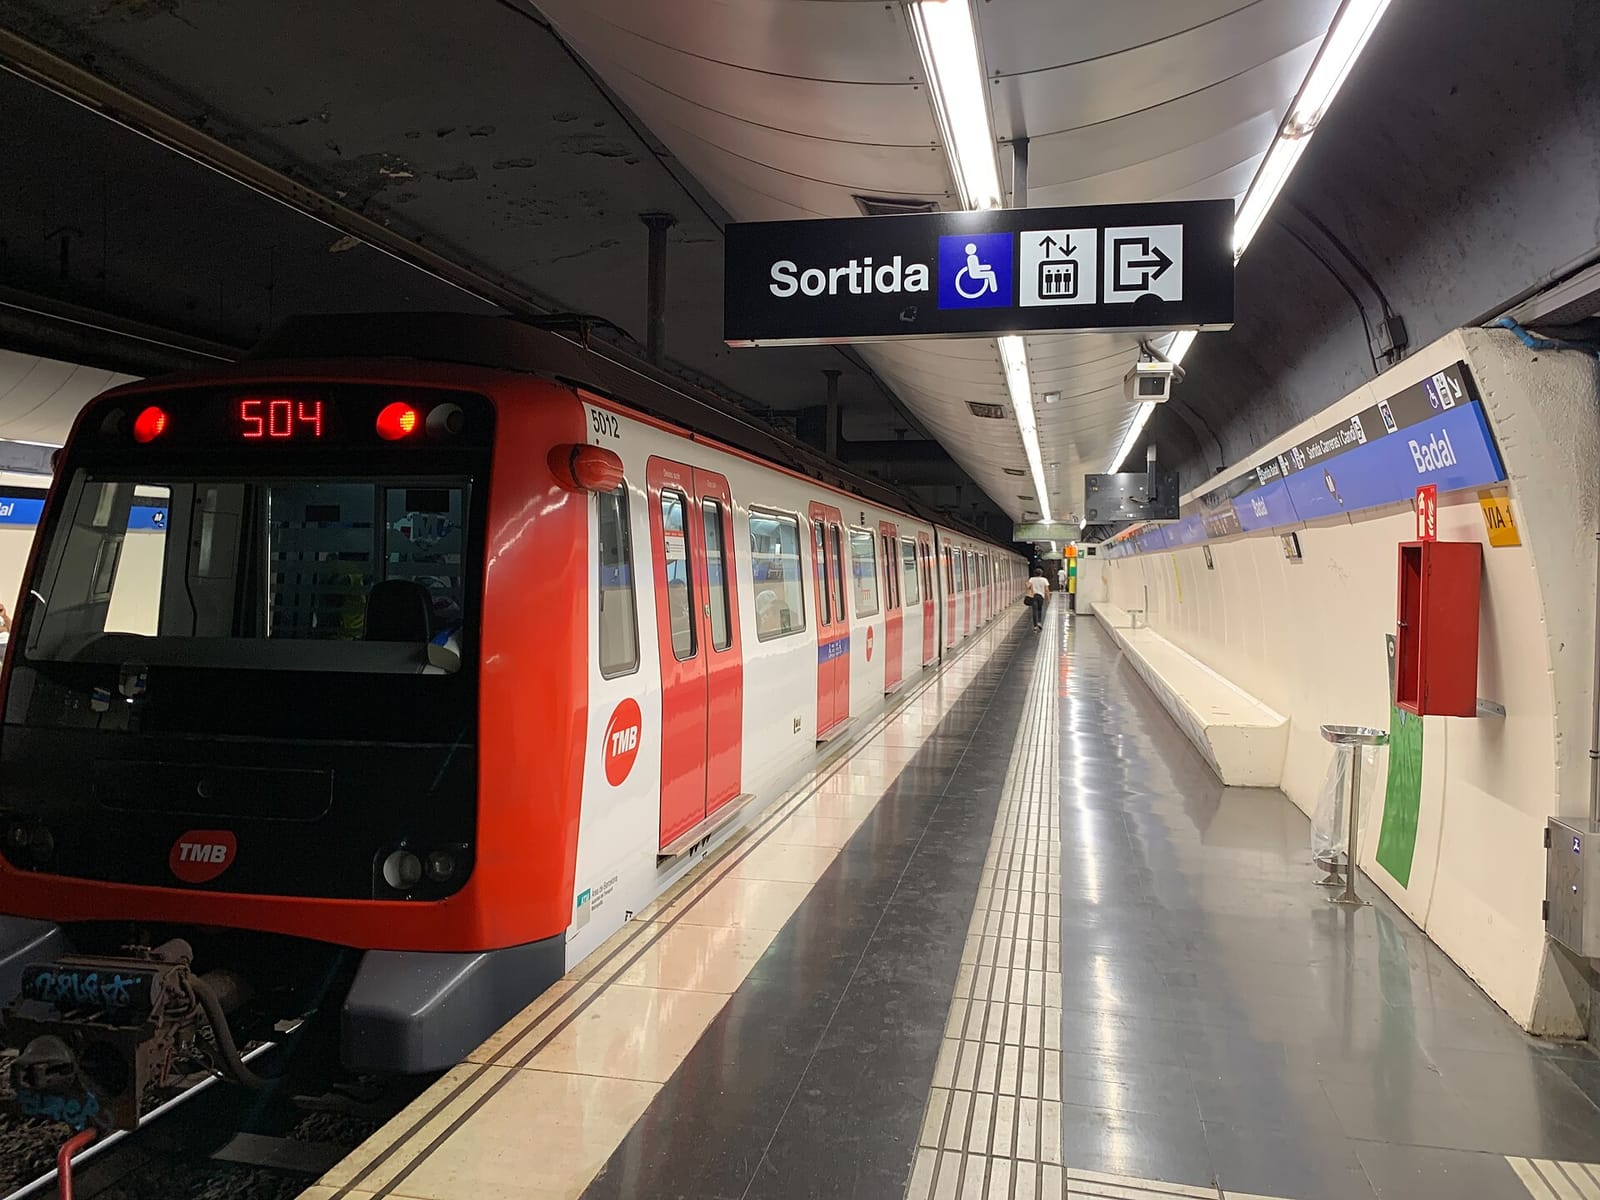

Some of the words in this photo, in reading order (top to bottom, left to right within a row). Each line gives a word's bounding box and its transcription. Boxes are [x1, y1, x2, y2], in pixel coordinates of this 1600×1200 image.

[769, 255, 929, 298] Sortida
[240, 400, 322, 437] 504
[590, 408, 620, 439] 5012
[1408, 428, 1457, 474] Badal
[1483, 505, 1506, 529] VIA
[611, 725, 638, 758] TMB
[179, 842, 228, 864] TMB
